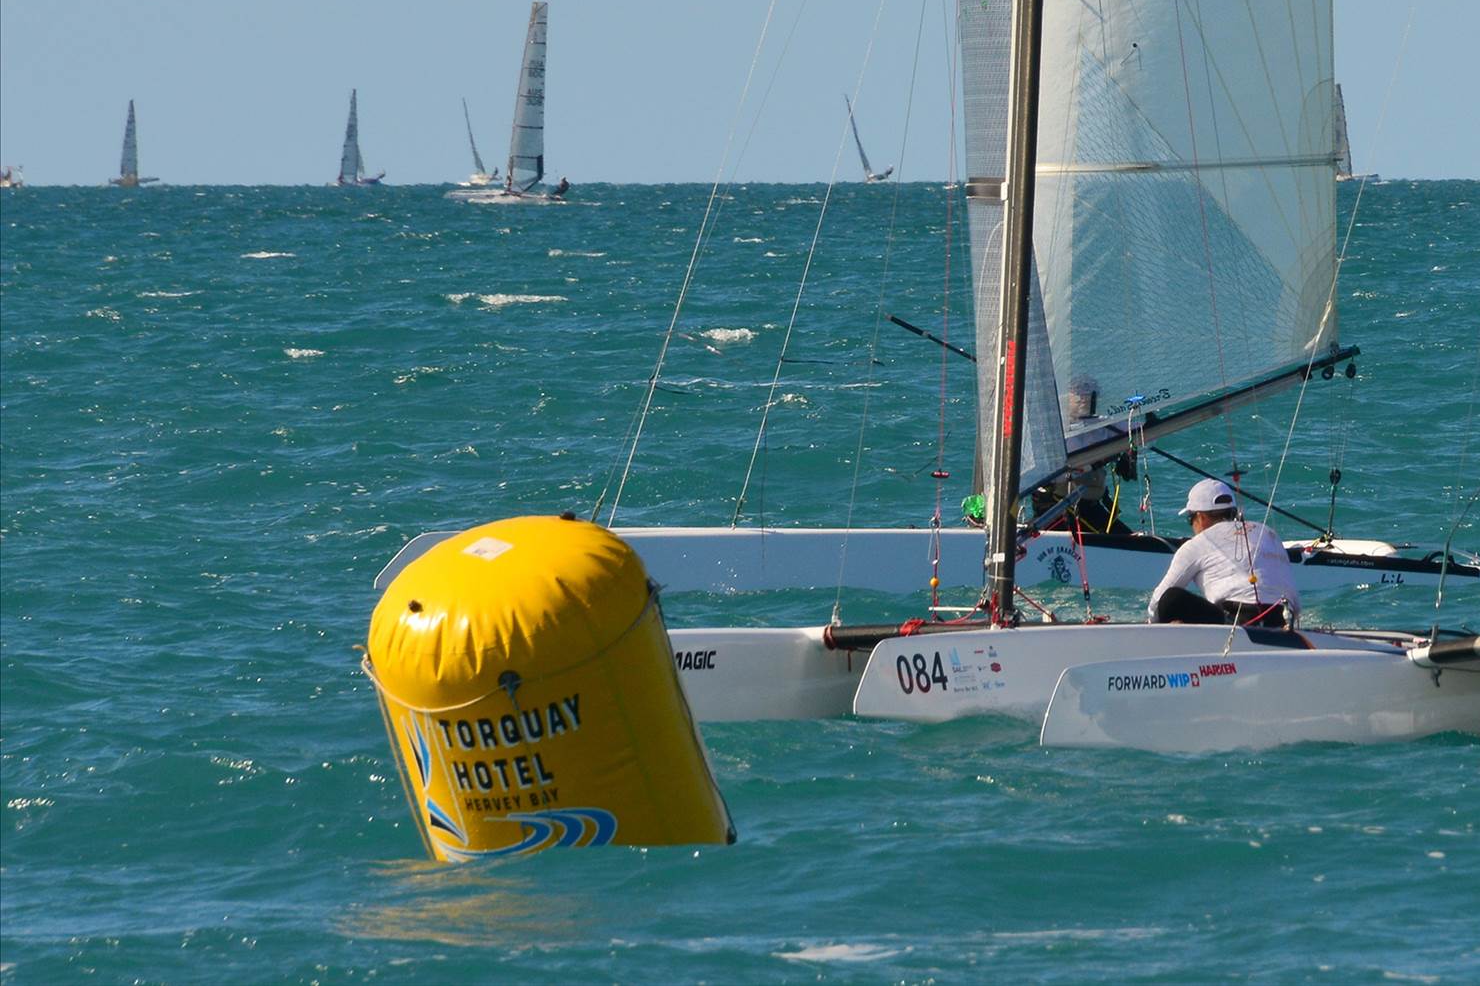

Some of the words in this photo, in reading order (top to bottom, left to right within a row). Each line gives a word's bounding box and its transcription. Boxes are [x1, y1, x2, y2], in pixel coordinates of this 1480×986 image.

[896, 651, 949, 695] 084
[1108, 674, 1166, 691] FORWARD
[1166, 673, 1190, 688] WIP
[437, 693, 582, 752] TORQUAY
[453, 753, 554, 793] HOTEL
[464, 795, 521, 813] HERVEY
[528, 788, 559, 807] BAY
